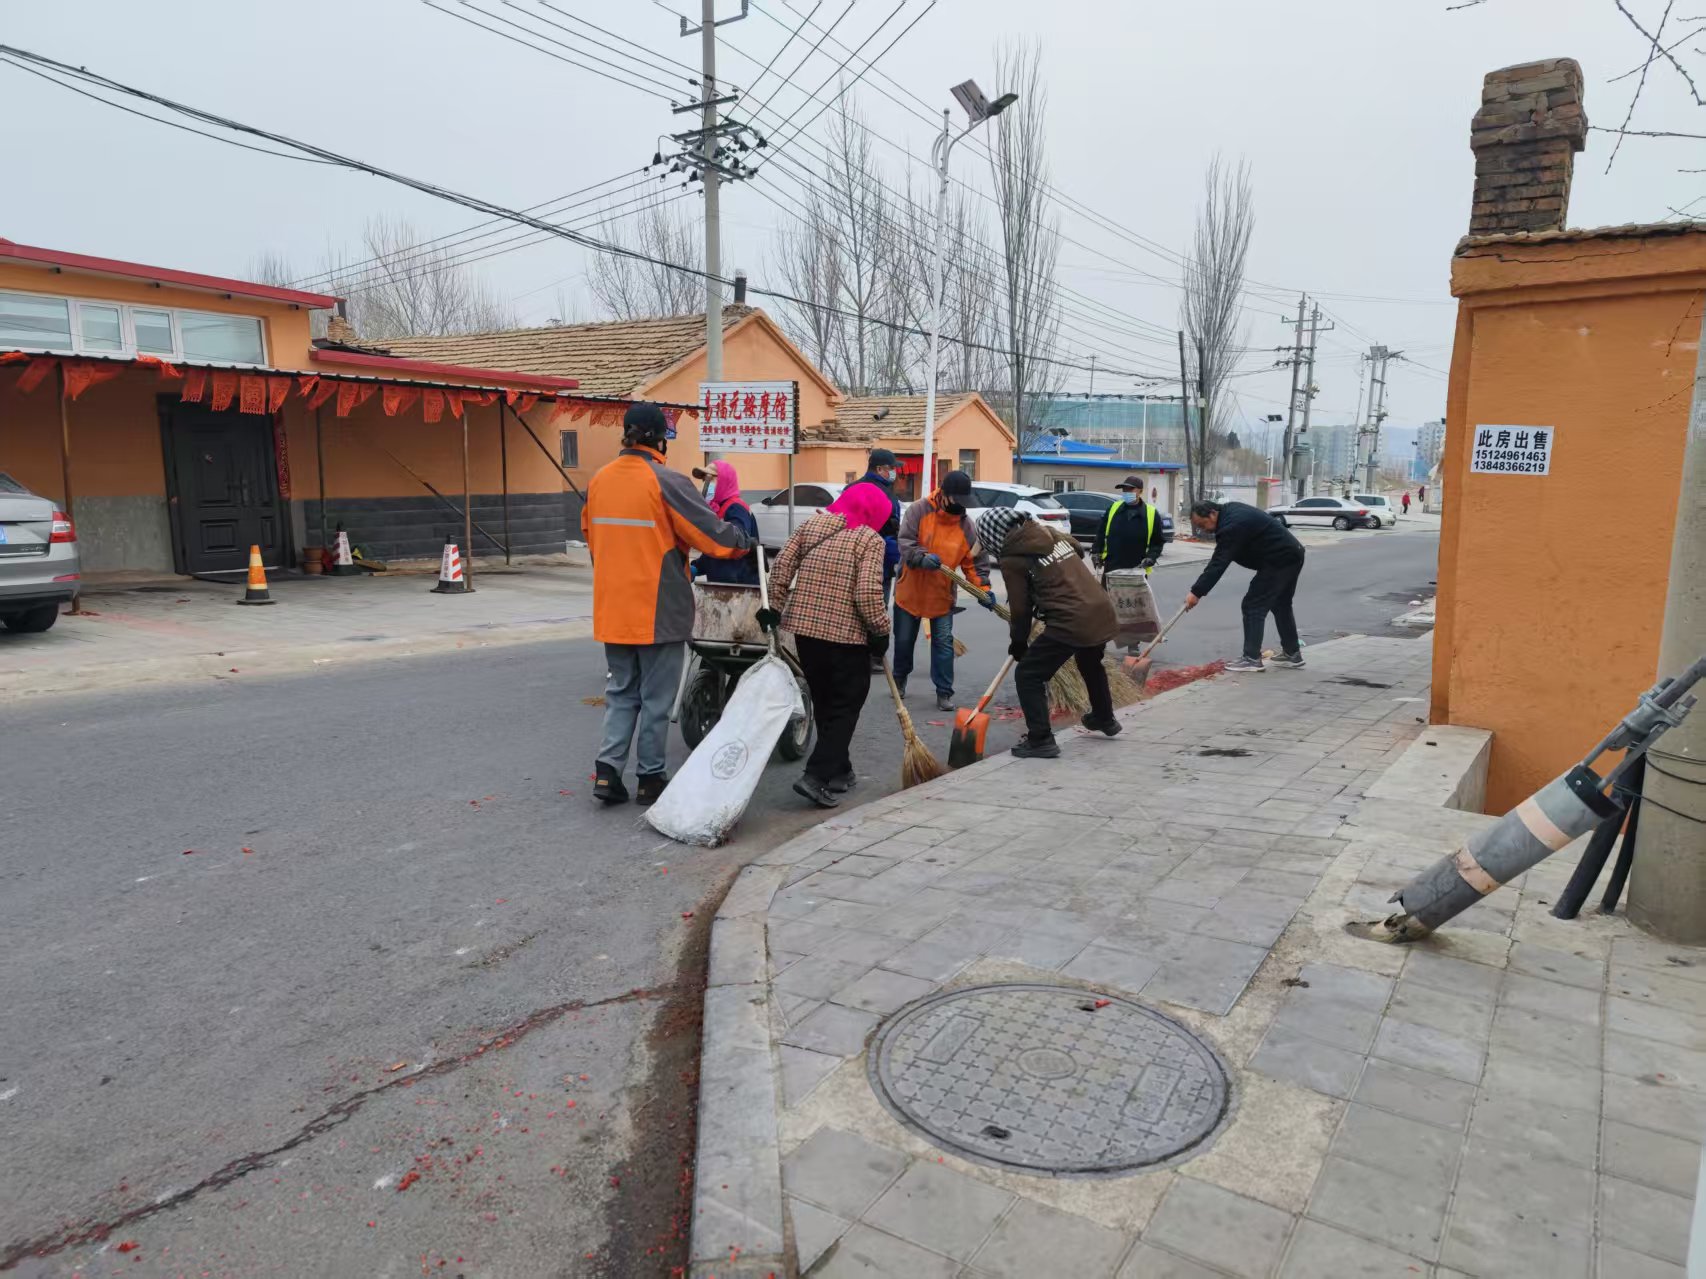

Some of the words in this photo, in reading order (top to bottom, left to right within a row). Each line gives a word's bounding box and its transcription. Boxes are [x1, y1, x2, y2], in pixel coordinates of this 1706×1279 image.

[1477, 430, 1549, 450] 此房出售
[1475, 449, 1547, 462] 15124961463
[1474, 460, 1546, 473] 13848366219
